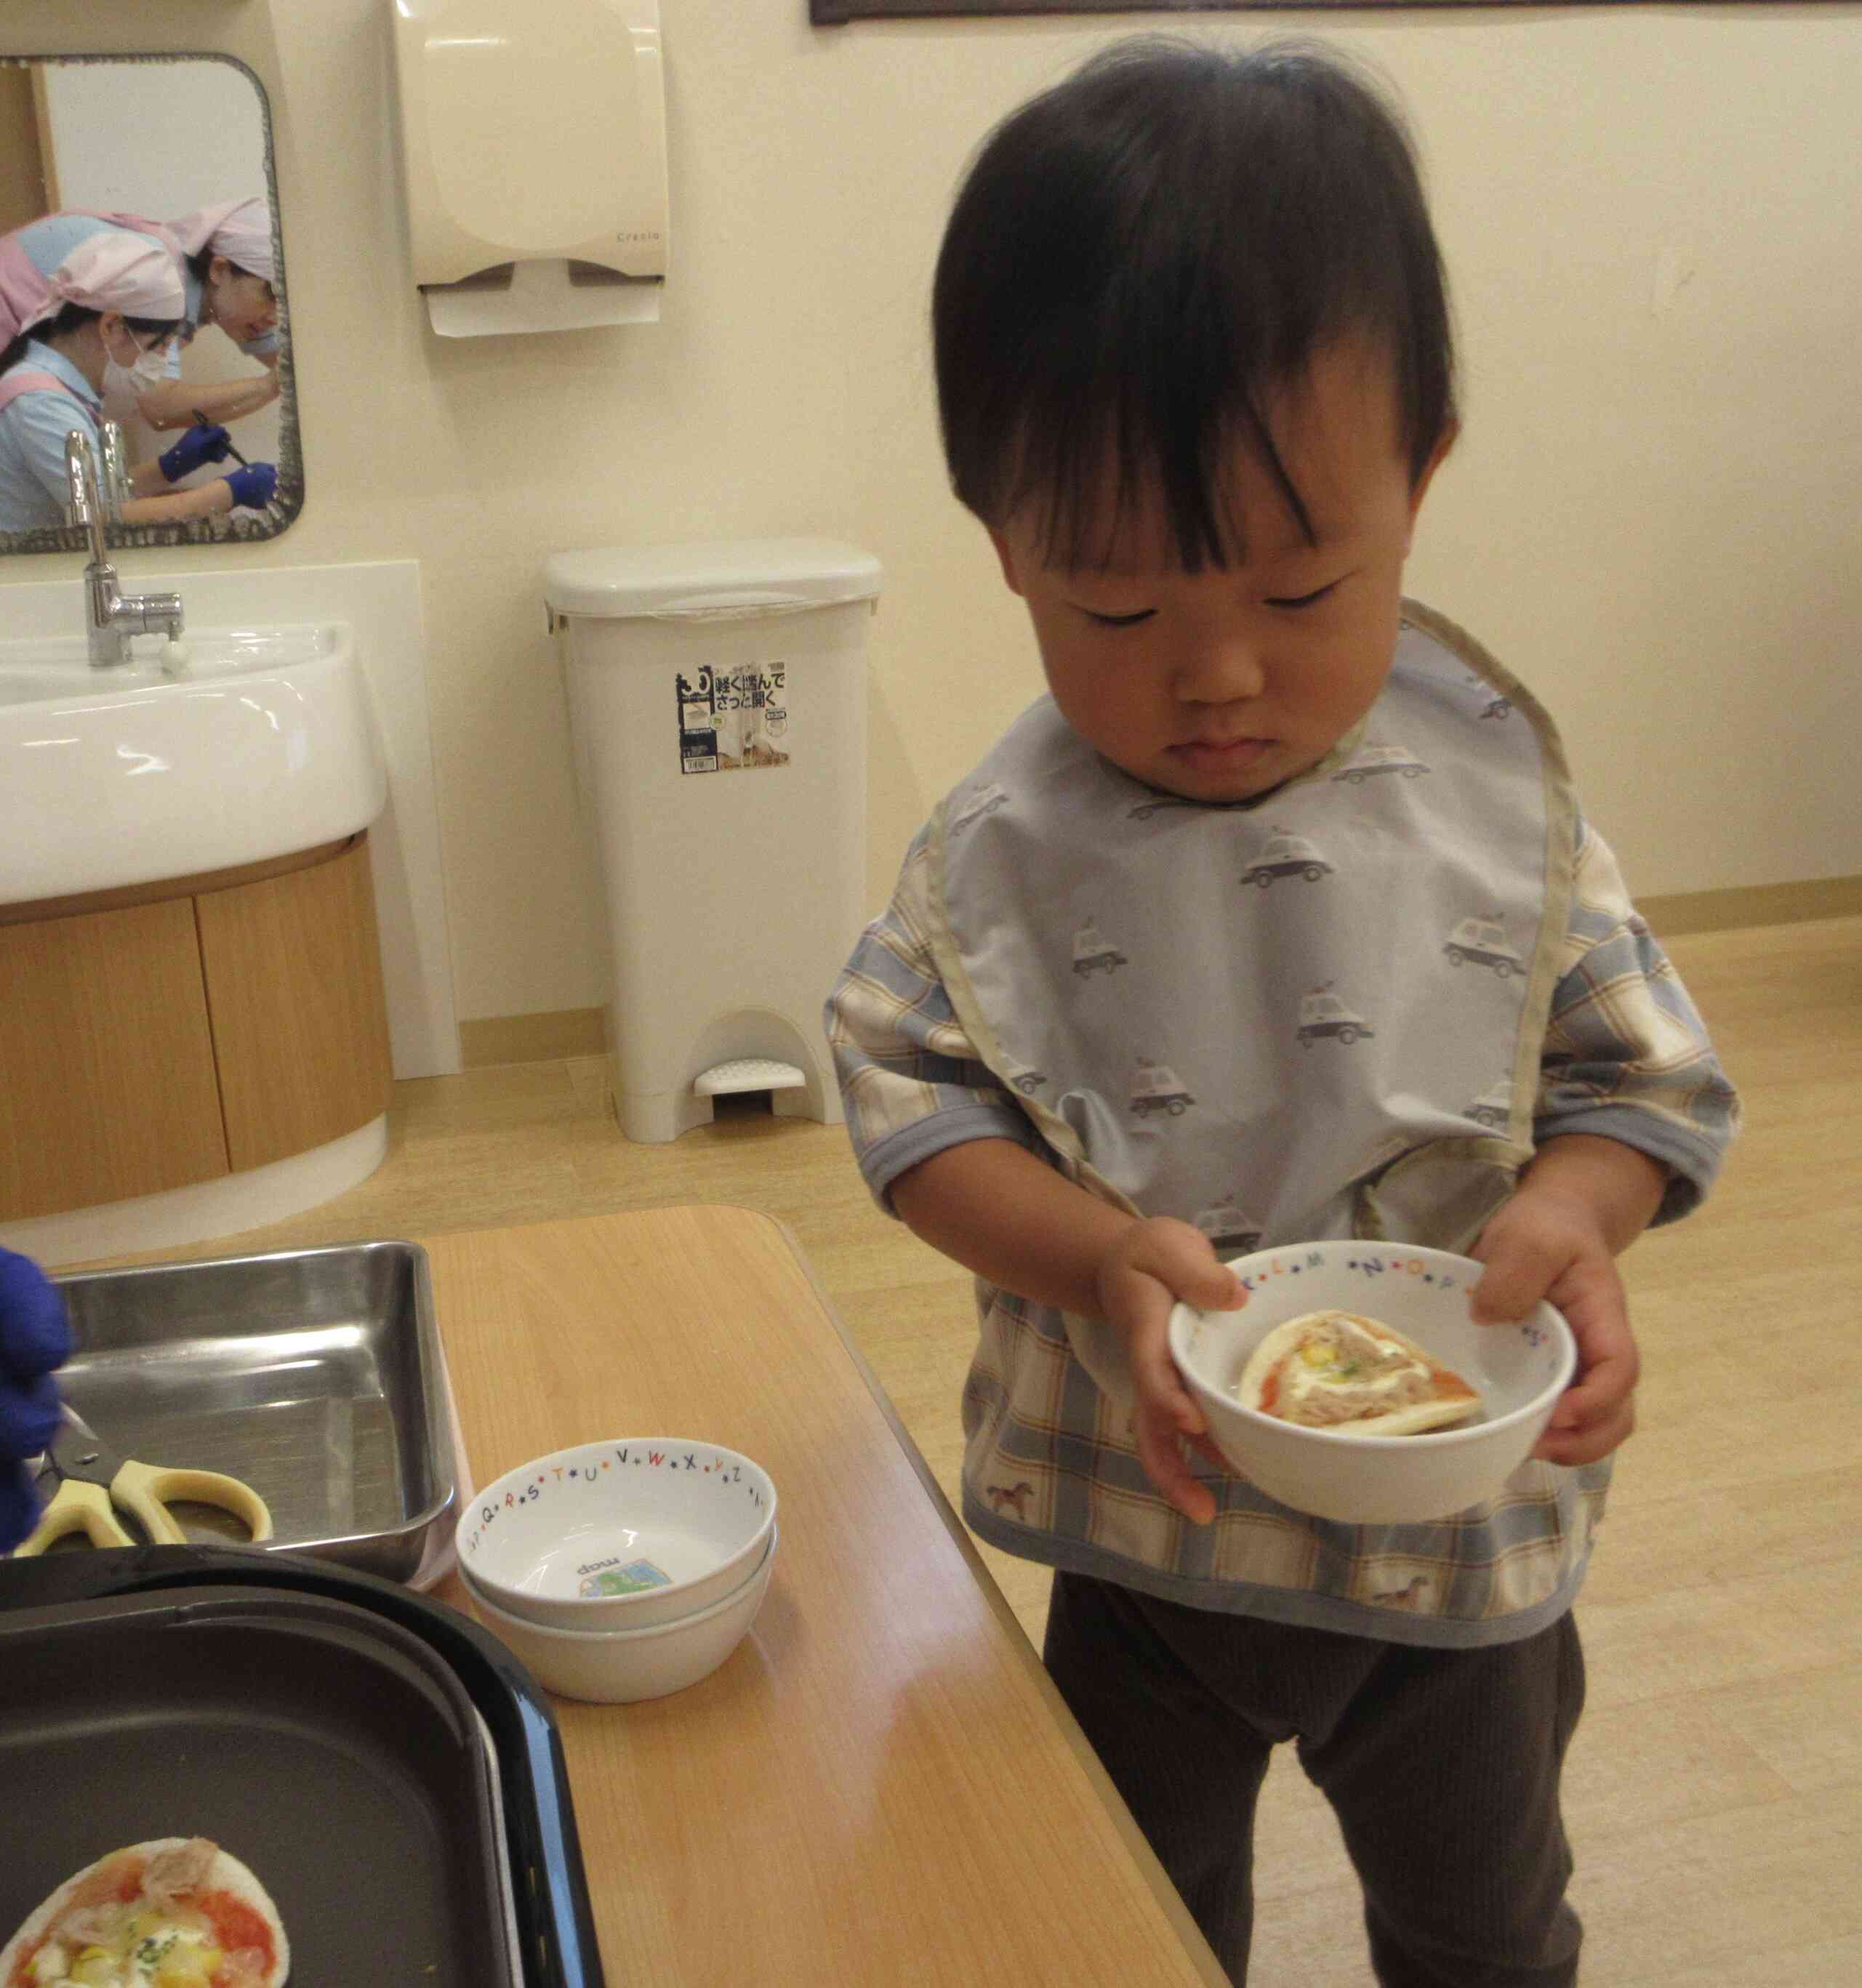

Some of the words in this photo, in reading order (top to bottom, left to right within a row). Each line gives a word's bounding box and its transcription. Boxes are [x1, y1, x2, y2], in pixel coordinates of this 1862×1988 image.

[1362, 1257, 1384, 1279] N
[483, 1507, 494, 1523] Q
[505, 1492, 514, 1508] R
[528, 1485, 539, 1500] S
[553, 1467, 563, 1481] T
[585, 1467, 598, 1481] U
[617, 1449, 627, 1463] V
[649, 1450, 666, 1466] W
[683, 1454, 697, 1470] X
[732, 1465, 742, 1482] Z
[577, 1558, 620, 1575] map
